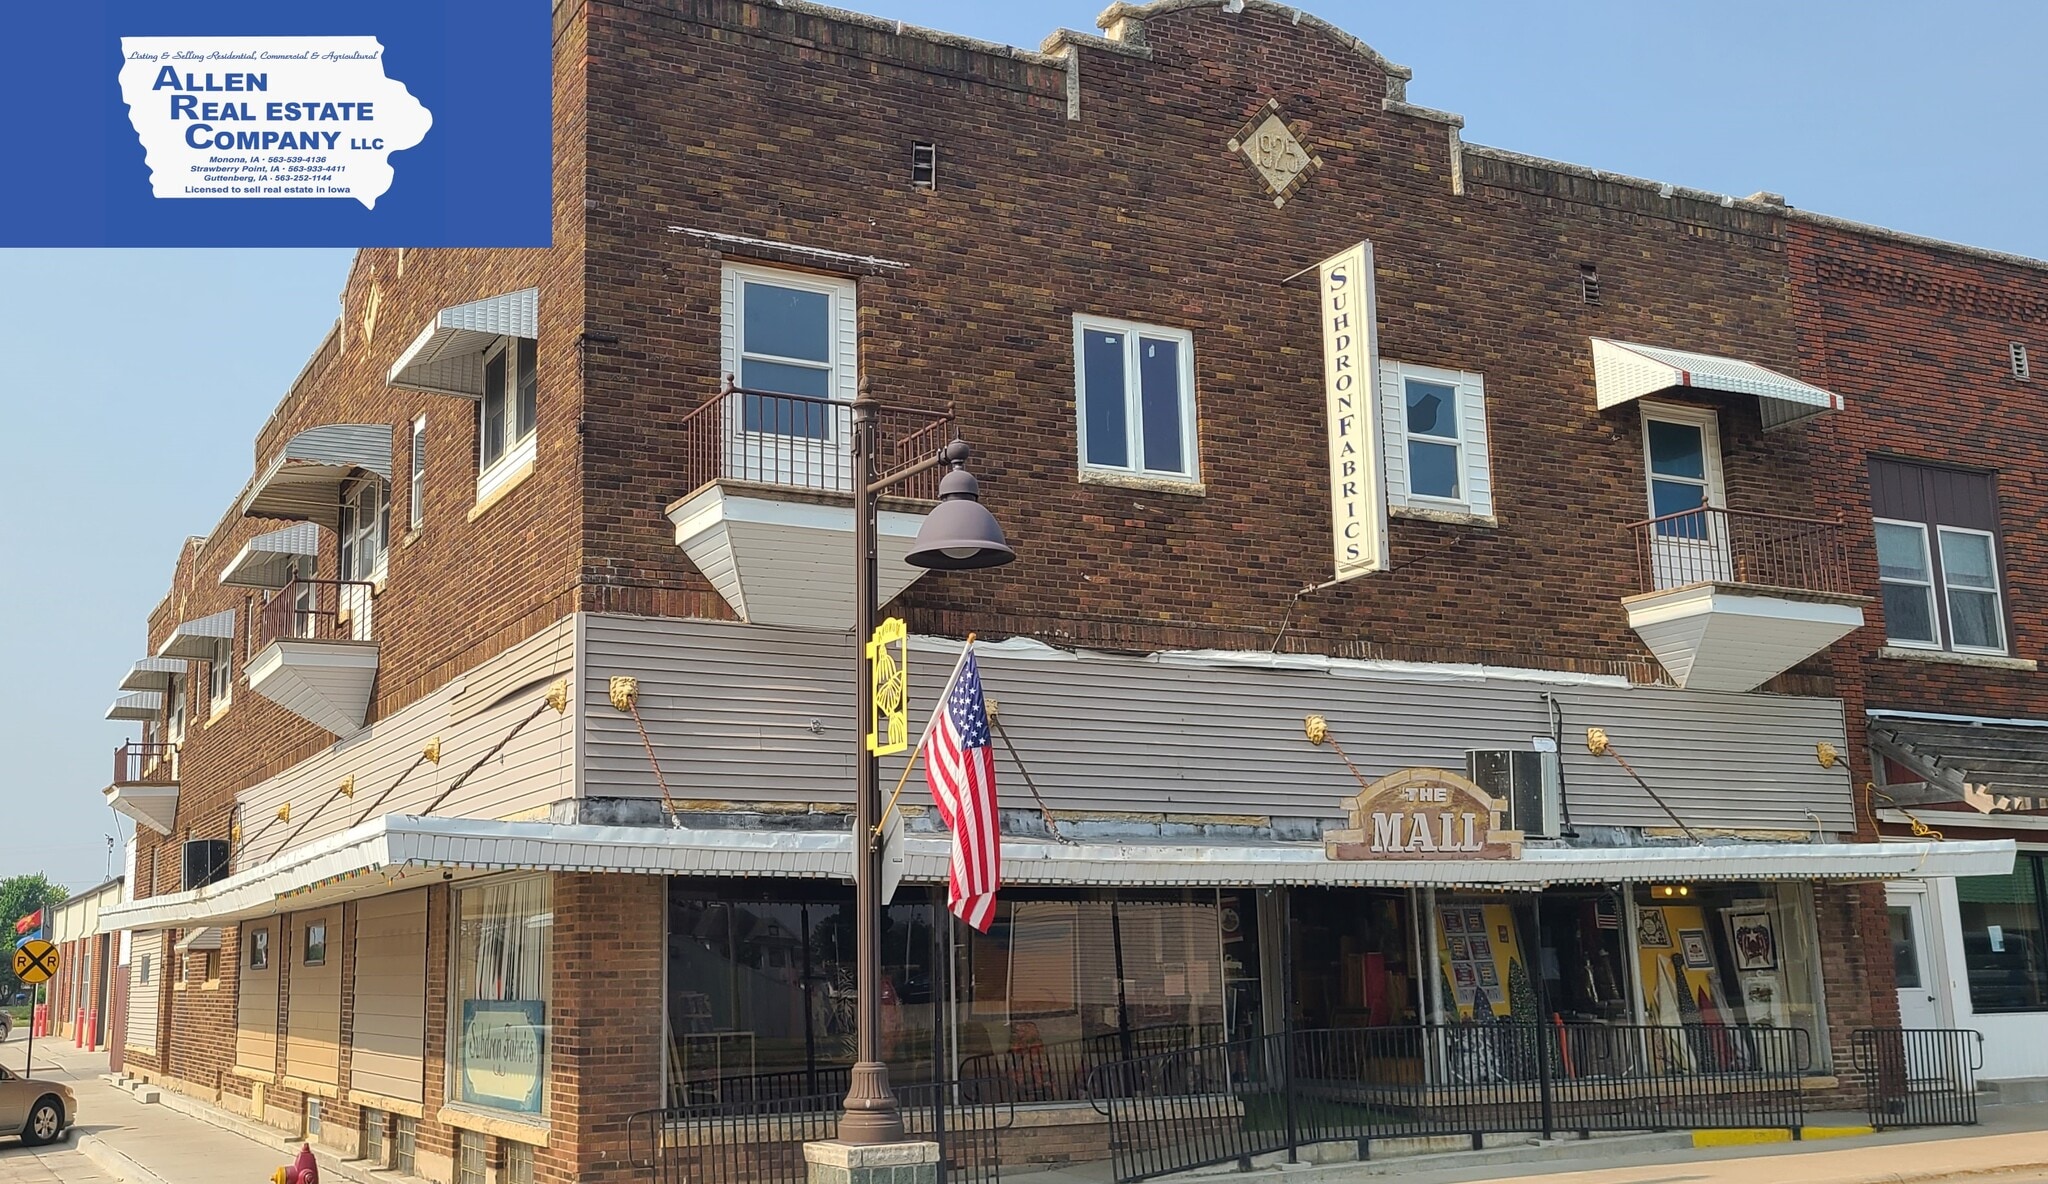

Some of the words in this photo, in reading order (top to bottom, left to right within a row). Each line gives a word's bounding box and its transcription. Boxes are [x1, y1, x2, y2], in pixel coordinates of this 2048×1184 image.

[1255, 133, 1299, 174] 1925
[1405, 787, 1447, 802] THE
[1370, 812, 1484, 853] MALL
[17, 956, 27, 967] R
[47, 956, 57, 967] R
[503, 1023, 534, 1063] Fabrics
